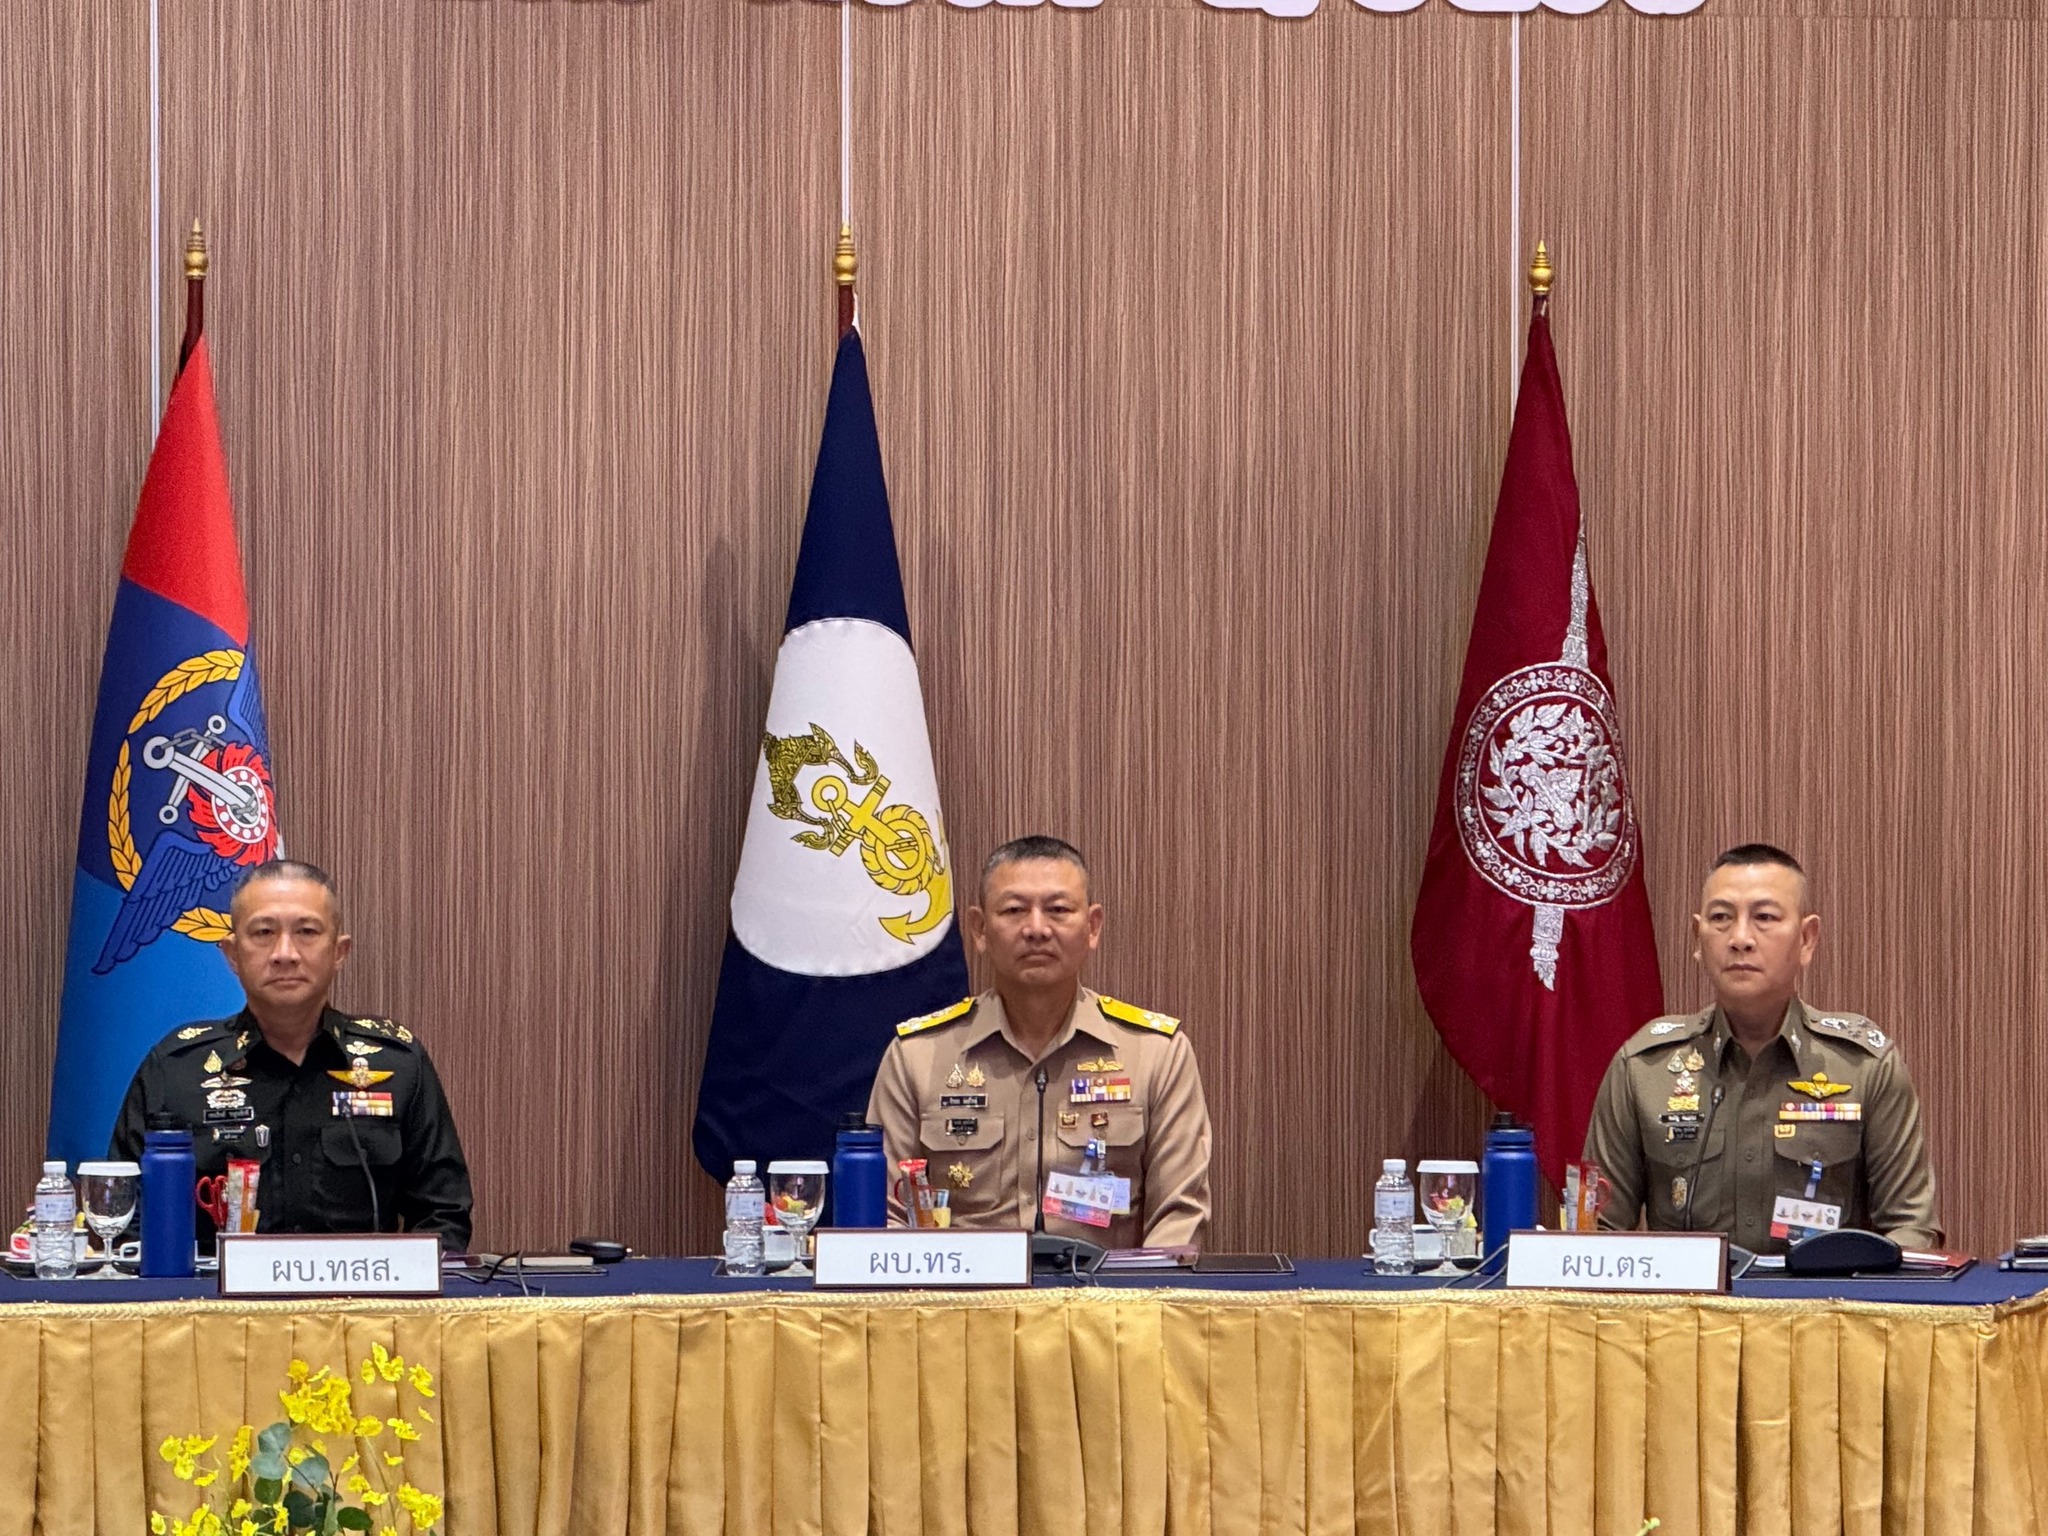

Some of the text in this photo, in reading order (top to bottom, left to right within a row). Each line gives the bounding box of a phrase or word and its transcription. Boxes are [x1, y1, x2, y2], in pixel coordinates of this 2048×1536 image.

[272, 1257, 400, 1282] ผบ.ทสส.
[869, 1252, 971, 1274] ผบ.ทร.
[1561, 1255, 1661, 1280] ผบ.ตร.
